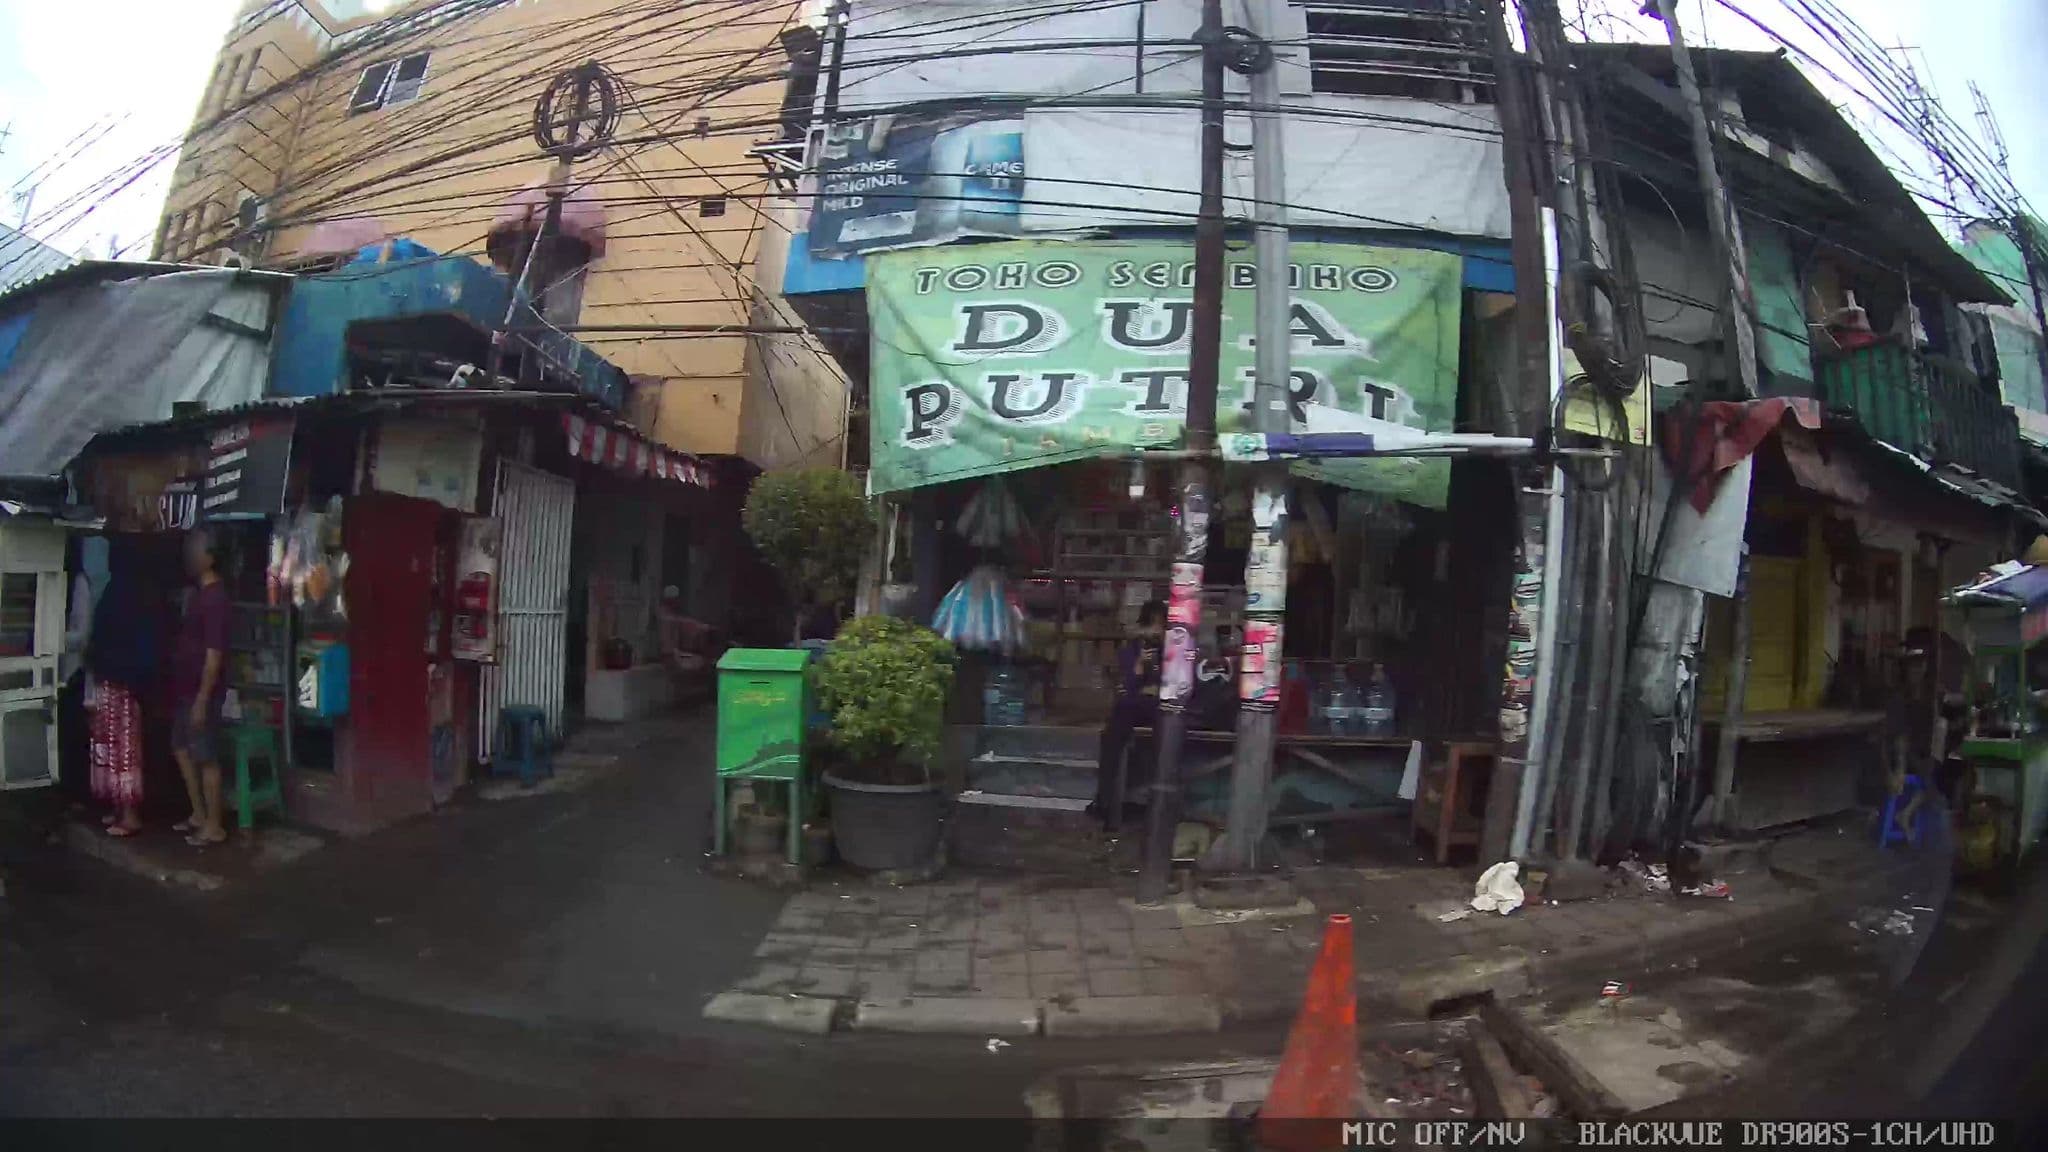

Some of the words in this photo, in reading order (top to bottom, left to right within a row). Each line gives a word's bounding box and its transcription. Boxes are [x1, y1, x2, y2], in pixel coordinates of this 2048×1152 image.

[823, 196, 864, 212] MILD
[917, 263, 1082, 293] TOKO
[950, 300, 1350, 354] DUA
